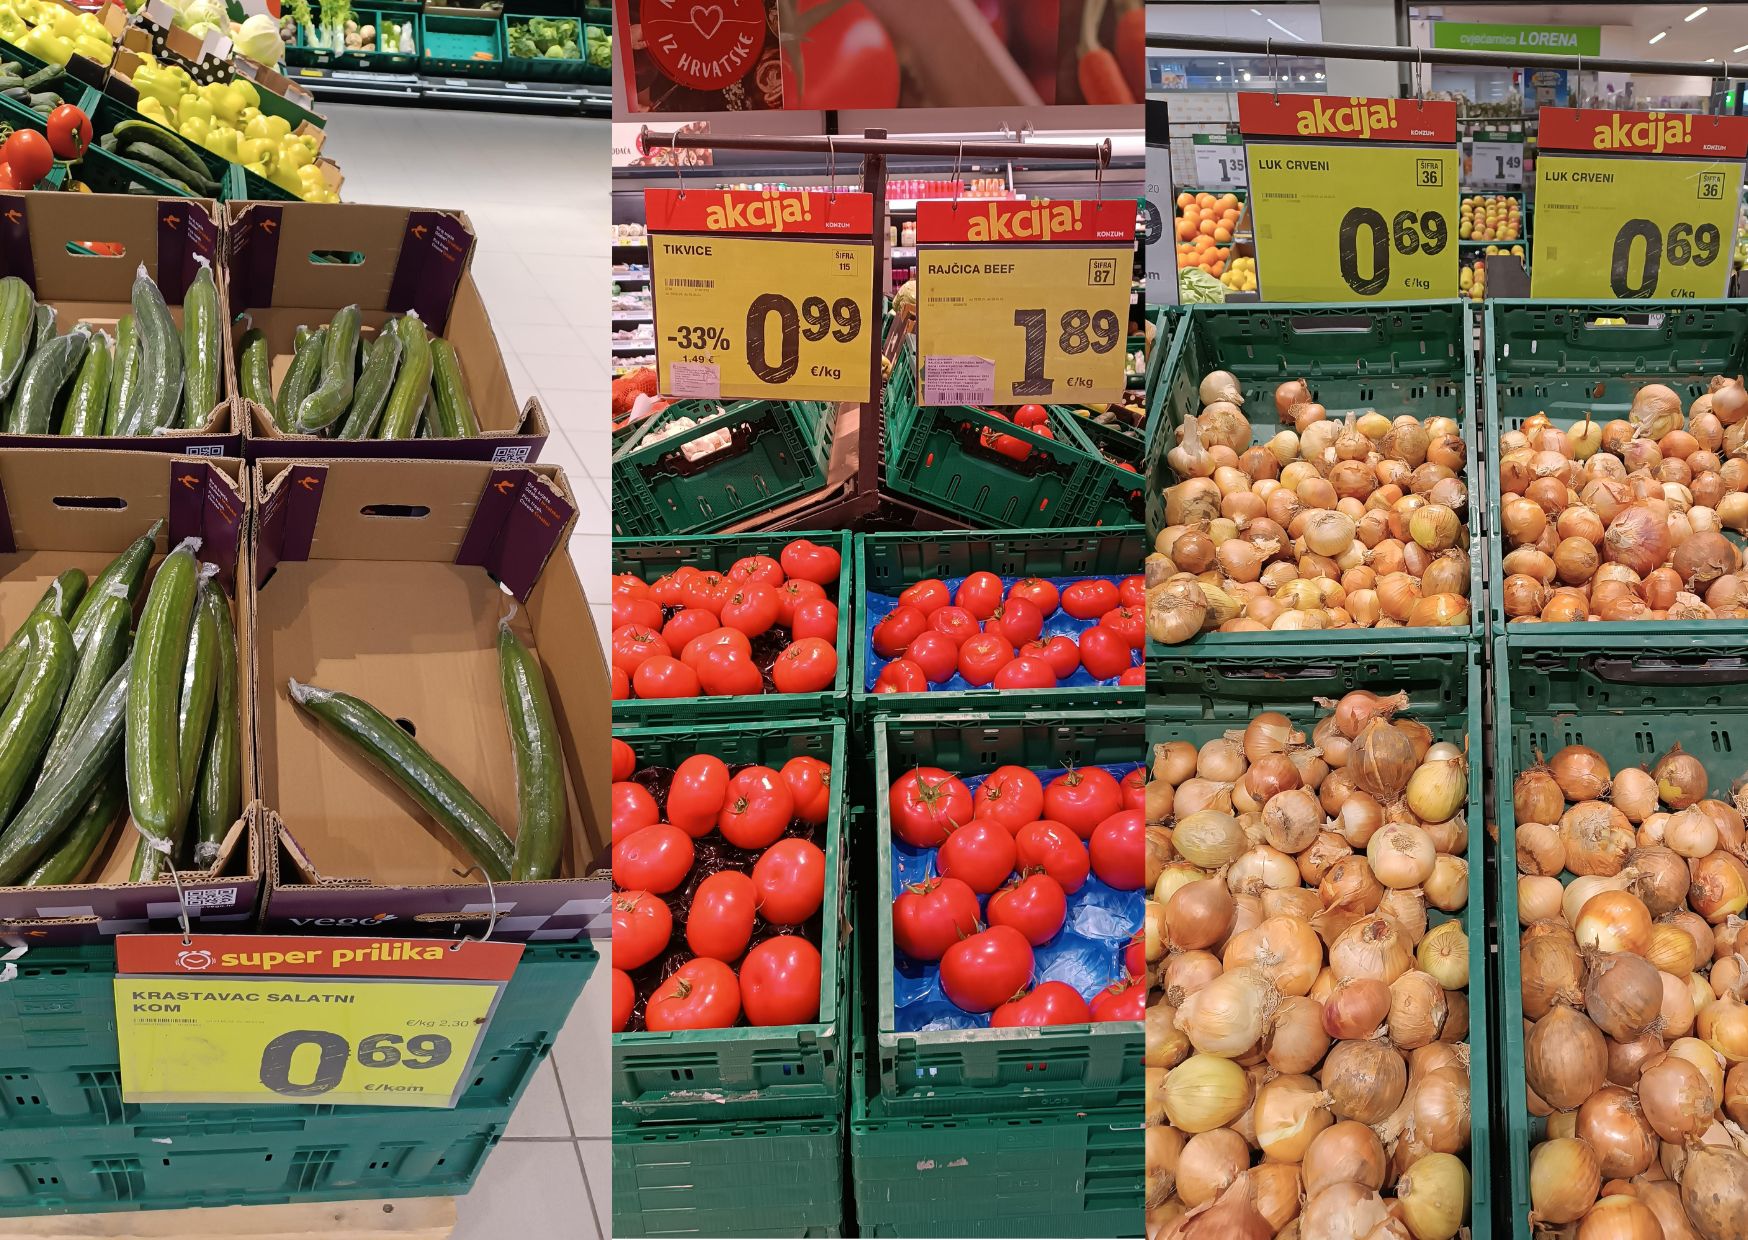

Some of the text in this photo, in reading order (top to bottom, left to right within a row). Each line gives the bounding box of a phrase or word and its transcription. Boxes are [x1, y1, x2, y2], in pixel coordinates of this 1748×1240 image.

[1519, 32, 1578, 47] LORENA
[658, 32, 754, 78] IZ HRVATSKE
[1296, 97, 1398, 139] akcija!
[1410, 129, 1435, 137] KONZUM
[1593, 112, 1692, 153] akcija!
[1218, 159, 1244, 182] 1 35
[1259, 160, 1330, 171] LUK CRVENI
[1420, 161, 1439, 170] ŠIFRA
[1495, 155, 1521, 179] 1 49
[1422, 171, 1438, 184] 36
[1545, 171, 1614, 183] LUK CRVENI
[1147, 183, 1160, 194] 20
[1703, 184, 1718, 197] 36
[706, 191, 812, 232] akcija!
[968, 200, 1082, 242] akcija!
[663, 244, 713, 256] TIKVICE
[835, 249, 855, 260] ŠIFRA
[1339, 206, 1448, 296] 0 69
[1093, 260, 1112, 269] ŠIFRA
[1610, 218, 1721, 298] 0 69
[839, 263, 851, 271] 115
[928, 262, 1015, 275] RAJČICA BEEF
[1094, 270, 1110, 283] 87
[1404, 278, 1430, 290] €/kg
[667, 325, 730, 351] -33%
[747, 293, 800, 384] 0
[802, 296, 862, 343] 99
[1012, 308, 1054, 396] 1
[1059, 309, 1119, 355] 89
[683, 355, 705, 363] 1.49
[811, 366, 841, 380] €/kg
[1067, 377, 1093, 389] €/kg
[221, 942, 444, 971] super prilika
[132, 991, 355, 1004] KRASTAVAC SALATNI
[133, 1003, 181, 1013] KOM
[406, 1019, 469, 1028] €/kg 2.30
[260, 1030, 452, 1097] 0 69
[364, 1083, 424, 1092] €/kom
